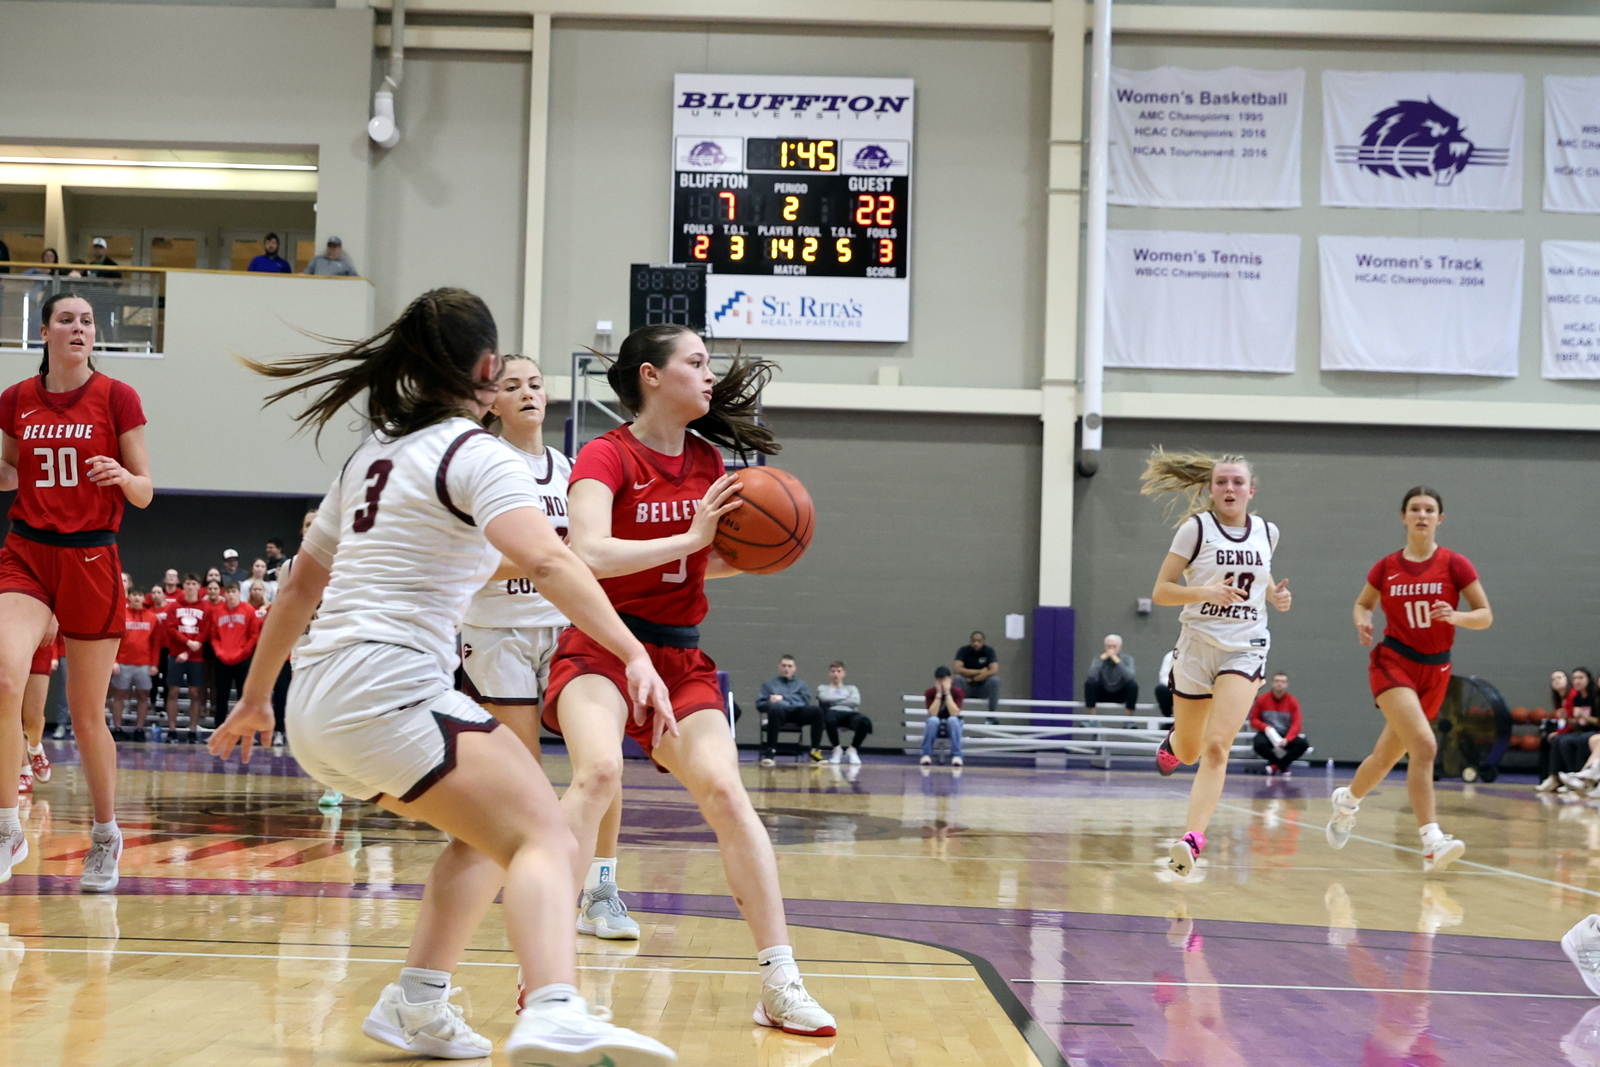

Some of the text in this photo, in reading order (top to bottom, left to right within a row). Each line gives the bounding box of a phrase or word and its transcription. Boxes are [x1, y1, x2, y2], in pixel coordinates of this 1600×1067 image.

[678, 92, 910, 113] BLUFFTON
[1116, 87, 1288, 106] Women's Basketball
[691, 110, 882, 121] UNIVERSITY
[1138, 110, 1165, 120] AMC
[1134, 127, 1168, 137] HCAC
[780, 140, 836, 171] 1:45
[679, 173, 748, 190] BLUFFTON
[774, 183, 808, 195] PERIOD
[848, 177, 894, 192] GUEST
[719, 192, 735, 220] 7
[782, 196, 799, 221] 2
[856, 194, 895, 226] 22
[683, 223, 714, 235] FOULS
[723, 224, 749, 236] T.O.L.
[757, 225, 822, 237] PLAYER FOUL
[830, 226, 857, 238] T.O.L.
[866, 228, 898, 239] FOULS
[694, 234, 710, 260] 2
[730, 235, 745, 260] 3
[771, 238, 794, 260] 14
[802, 237, 818, 262] 2
[836, 237, 852, 263] 5
[879, 238, 894, 264] 3
[1133, 248, 1263, 266] Women's Tennis
[1355, 254, 1483, 271] Women's Track
[773, 264, 807, 276] MATCH
[865, 266, 897, 278] SCORE
[761, 318, 862, 329] HEALTH PARTNERS
[22, 424, 94, 440] BELLEVUE
[33, 447, 79, 488] 30
[352, 459, 394, 533] 3
[1216, 550, 1263, 566] GENOA
[1390, 582, 1443, 597] BELLEVUE
[1200, 602, 1258, 621] COMETS
[1403, 600, 1432, 629] 10
